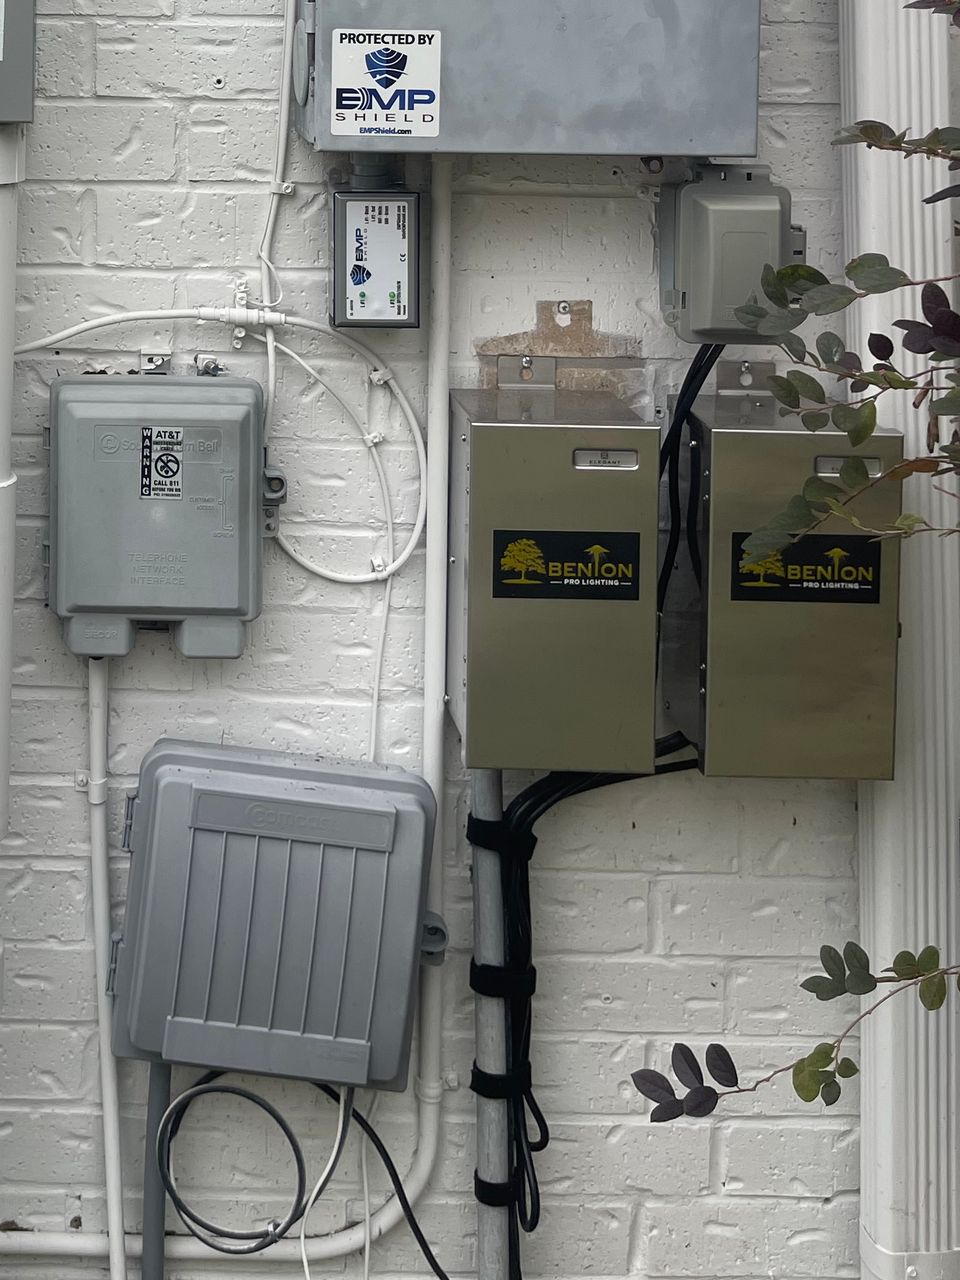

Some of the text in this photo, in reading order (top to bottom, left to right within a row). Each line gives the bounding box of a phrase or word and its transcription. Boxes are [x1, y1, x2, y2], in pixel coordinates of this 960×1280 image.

[339, 33, 435, 46] PROTECTED BY
[335, 88, 436, 110] EMP
[335, 112, 434, 123] SHIELD
[359, 127, 412, 135] EMPShield.com
[355, 228, 363, 261] EMP
[156, 430, 181, 440] AT&T
[199, 441, 218, 451] Bell
[142, 429, 152, 495] WARNING
[128, 552, 188, 562] TELEPHONE
[132, 565, 183, 574] NETWORK
[130, 577, 185, 585] INTERFACE
[821, 582, 860, 590] LIGHTING
